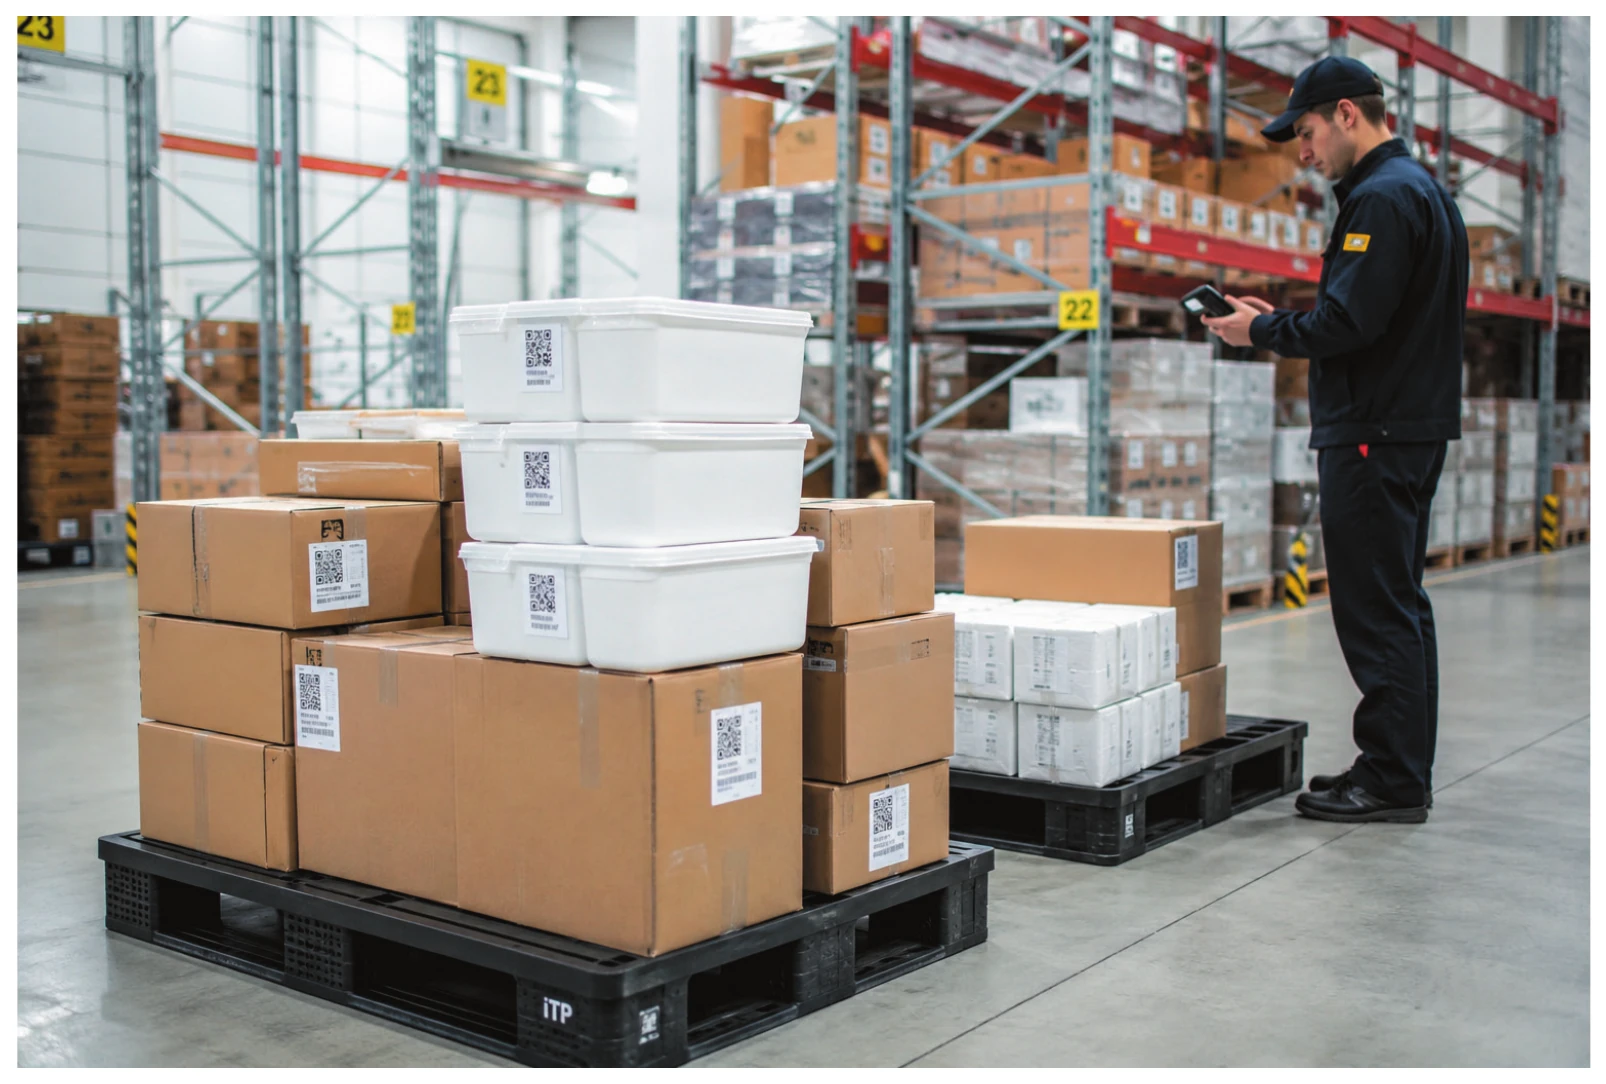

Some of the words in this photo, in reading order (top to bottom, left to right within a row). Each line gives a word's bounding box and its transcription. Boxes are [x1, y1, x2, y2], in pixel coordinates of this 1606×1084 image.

[17, 16, 54, 41] 23
[474, 68, 499, 97] 23
[1065, 298, 1092, 321] 22
[543, 996, 573, 1024] iTP
